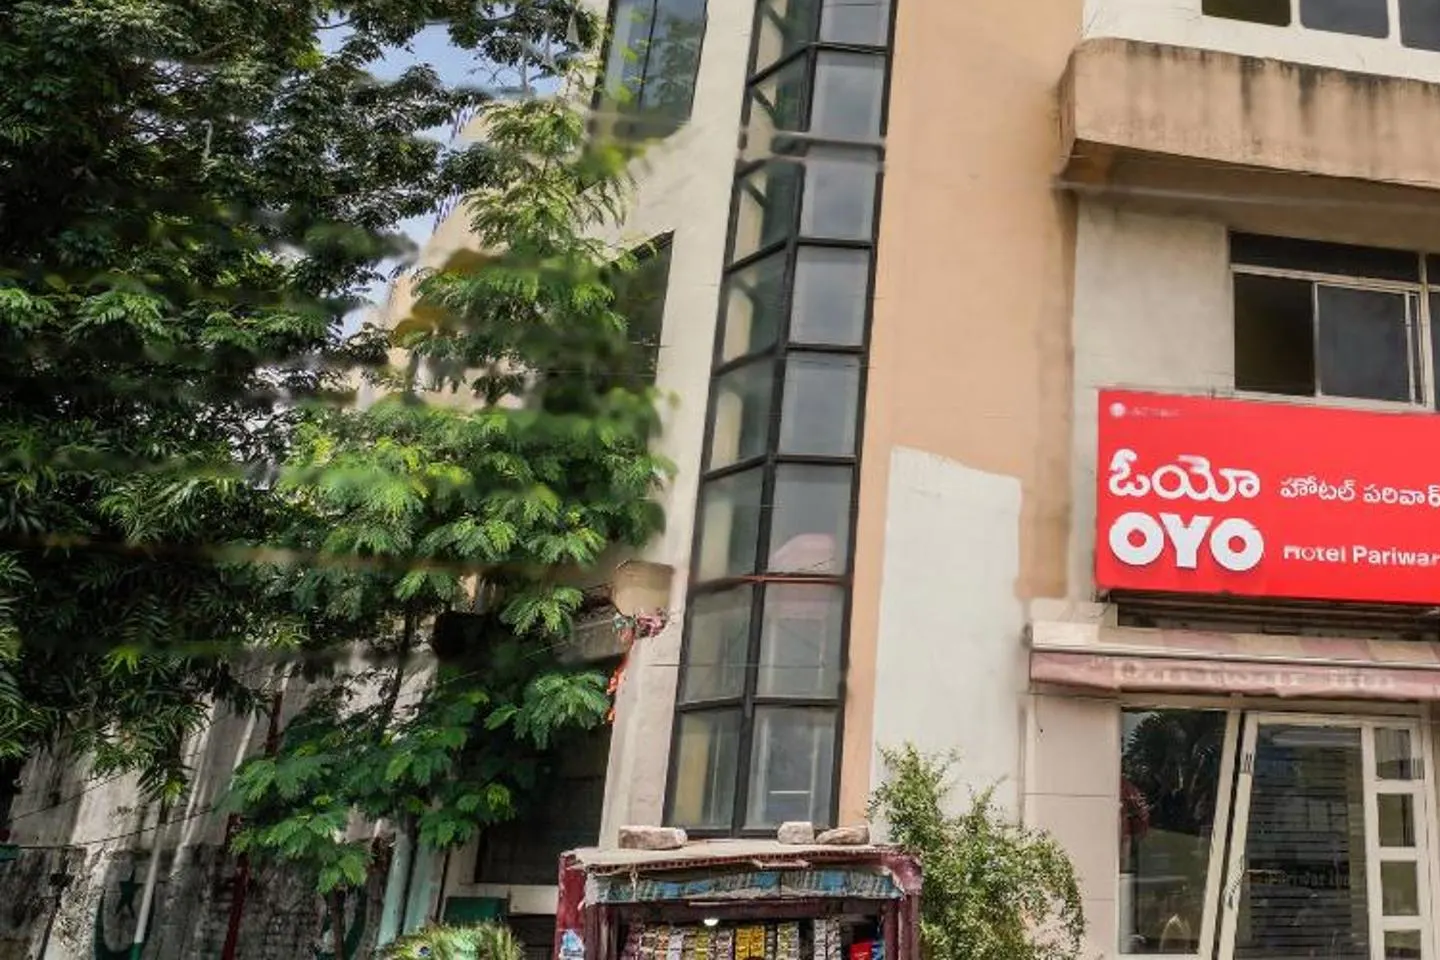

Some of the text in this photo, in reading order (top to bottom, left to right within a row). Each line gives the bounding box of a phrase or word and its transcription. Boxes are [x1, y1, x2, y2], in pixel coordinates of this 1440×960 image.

[1109, 448, 1261, 502] ఓయో
[1280, 473, 1355, 501] హోటల్
[1108, 511, 1265, 571] OYO
[1283, 544, 1346, 562] Hotel
[1352, 544, 1440, 566] Pariwar
